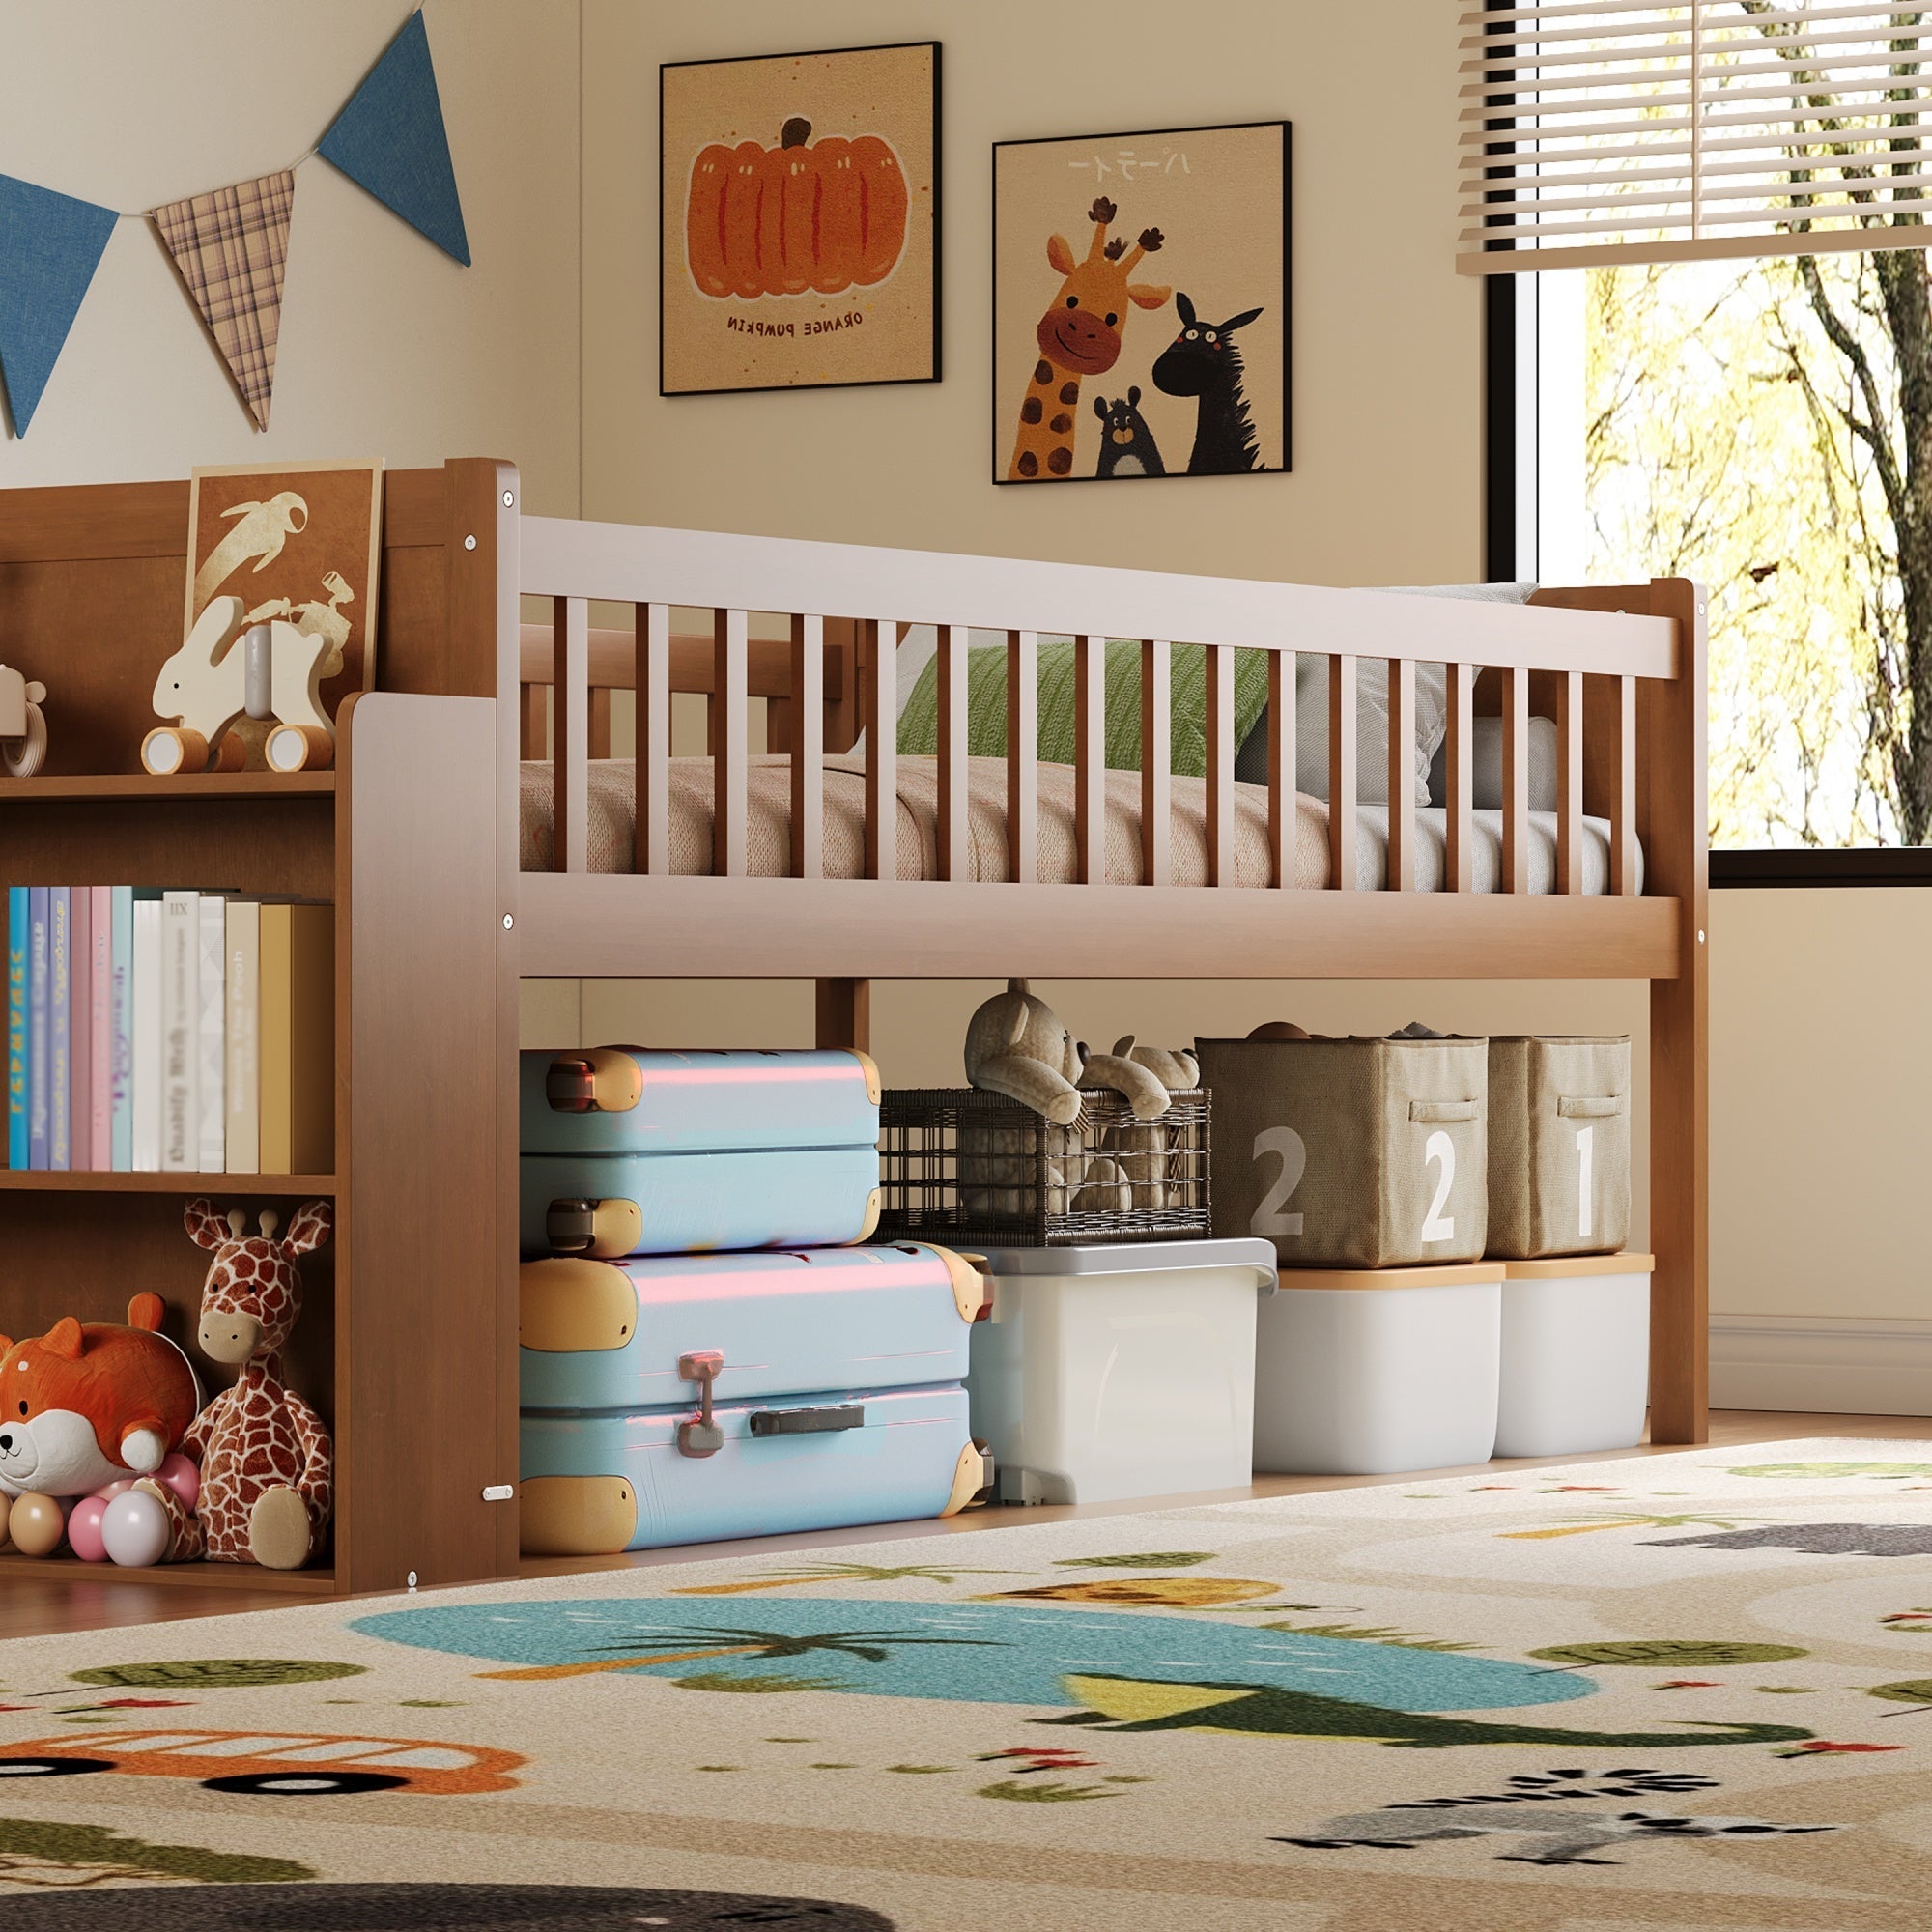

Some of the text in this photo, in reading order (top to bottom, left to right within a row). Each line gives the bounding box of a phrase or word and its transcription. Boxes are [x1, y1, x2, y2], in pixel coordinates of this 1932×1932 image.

[1249, 1125, 1307, 1236] 2
[1421, 1130, 1456, 1242] 2
[1576, 1125, 1593, 1236] 1
